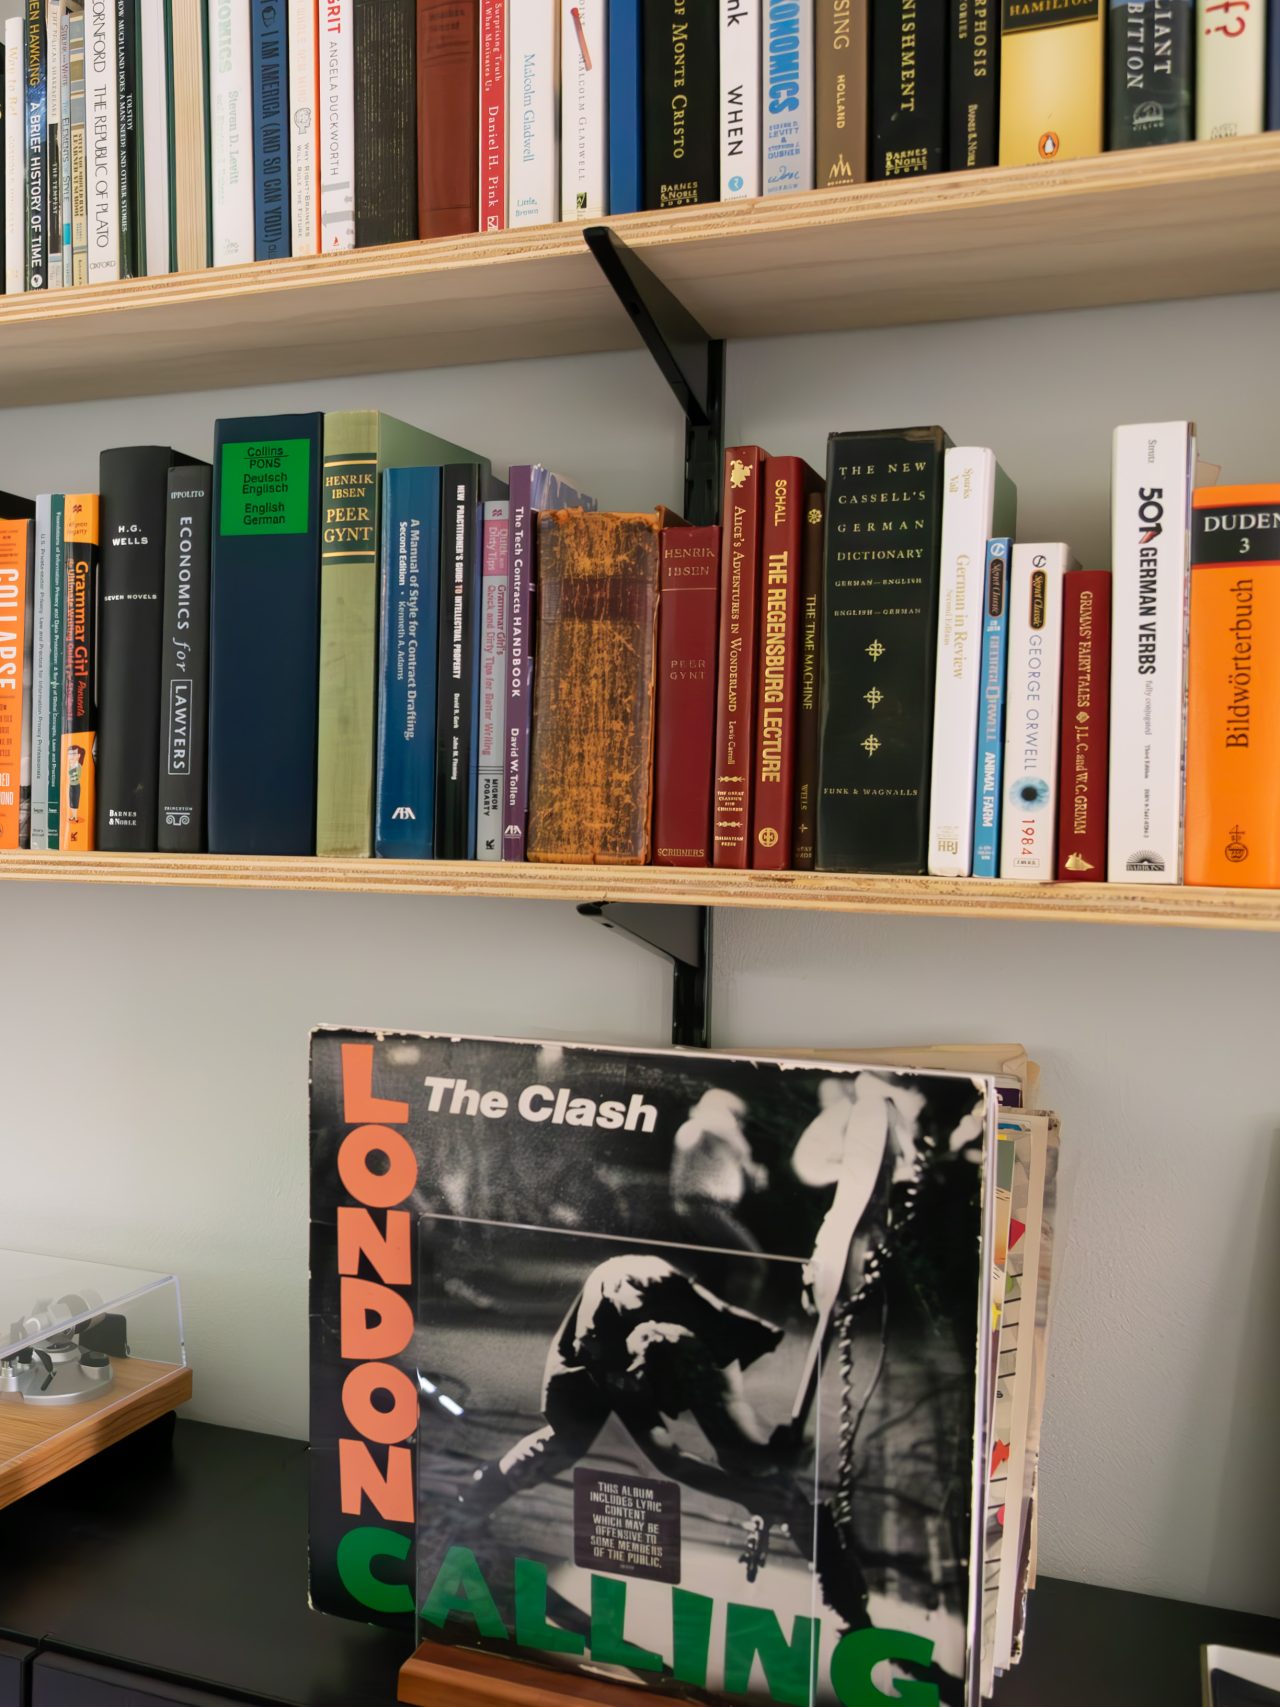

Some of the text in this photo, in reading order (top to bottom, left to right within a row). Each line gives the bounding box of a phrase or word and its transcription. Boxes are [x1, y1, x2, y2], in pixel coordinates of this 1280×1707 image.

[261, 41, 280, 59] AM
[261, 64, 281, 119] AMERICA
[672, 23, 688, 159] MONTE CRISTO
[836, 75, 846, 129] HOLLAND
[329, 42, 339, 176] ANGELA DUCKWORTH
[523, 54, 535, 162] Malcolm Gladwell
[728, 85, 743, 157] WHEN
[29, 23, 41, 267] HAWKING A BRIEF HISTORY OF TIME
[488, 106, 499, 207] Daniel H. Pink
[93, 84, 109, 247] THE REPUBLIC OF PLATO
[262, 158, 281, 174] SO
[262, 180, 282, 202] CAN
[247, 447, 284, 457] Collins
[249, 458, 281, 469] PONS
[243, 472, 287, 483] Deutsch
[325, 474, 374, 487] HENRIK
[839, 463, 927, 476] THE NEW
[242, 482, 288, 495] Englisch
[332, 488, 366, 499] IBSEN
[774, 479, 788, 526] SCHALL
[838, 490, 926, 504] CASSELL'S
[243, 515, 286, 525] German
[245, 501, 285, 514] English
[327, 507, 370, 524] PEER
[324, 527, 374, 543] GYNT
[409, 519, 420, 528] A
[837, 520, 925, 532] GERMAN
[408, 531, 420, 573] Manual
[837, 549, 924, 561] DICTIONARY
[1239, 537, 1251, 553] 3
[407, 576, 420, 588] of
[1139, 546, 1158, 616] GERMAN
[405, 590, 420, 618] Style
[511, 506, 524, 698] The Tech Contracts HANDBOOK
[728, 506, 746, 712] ALICE'S ADVENTURES IN WONDERLAND
[953, 554, 970, 680] German in Review
[74, 561, 89, 676] Grammar Girl
[406, 620, 419, 637] for
[173, 516, 193, 770] ECONOMICS for LAWYERS
[802, 594, 816, 710] THE TIME MACHINE
[1077, 641, 1093, 672] FAIRY
[1138, 622, 1157, 675] VERBS
[405, 640, 418, 688] Contract
[762, 551, 788, 782] THE REGENSBURG LECTURE
[1225, 579, 1254, 749] Bildwörterbuch
[1024, 635, 1042, 771] GEORGE ORWELL
[1077, 673, 1091, 708] TALES
[510, 728, 520, 755] David
[509, 774, 519, 806] Tollen
[982, 752, 995, 828] ANIMAL FARM
[1020, 819, 1036, 856] 1984
[424, 1076, 658, 1133] The Clash
[336, 1042, 418, 1523] LONDON
[590, 1492, 662, 1512] INCLUDES LYRIC
[598, 1481, 654, 1500] THIS ALBUM
[593, 1514, 660, 1534] WHICH MAY BE
[605, 1505, 646, 1519] CONTENT
[590, 1536, 663, 1556] SOME MEMBERS
[595, 1525, 657, 1544] OFFENSIVE TO
[593, 1547, 605, 1557] OF
[608, 1549, 624, 1561] THE
[628, 1552, 662, 1568] PUBLIC.
[336, 1526, 940, 1707] CALLING
